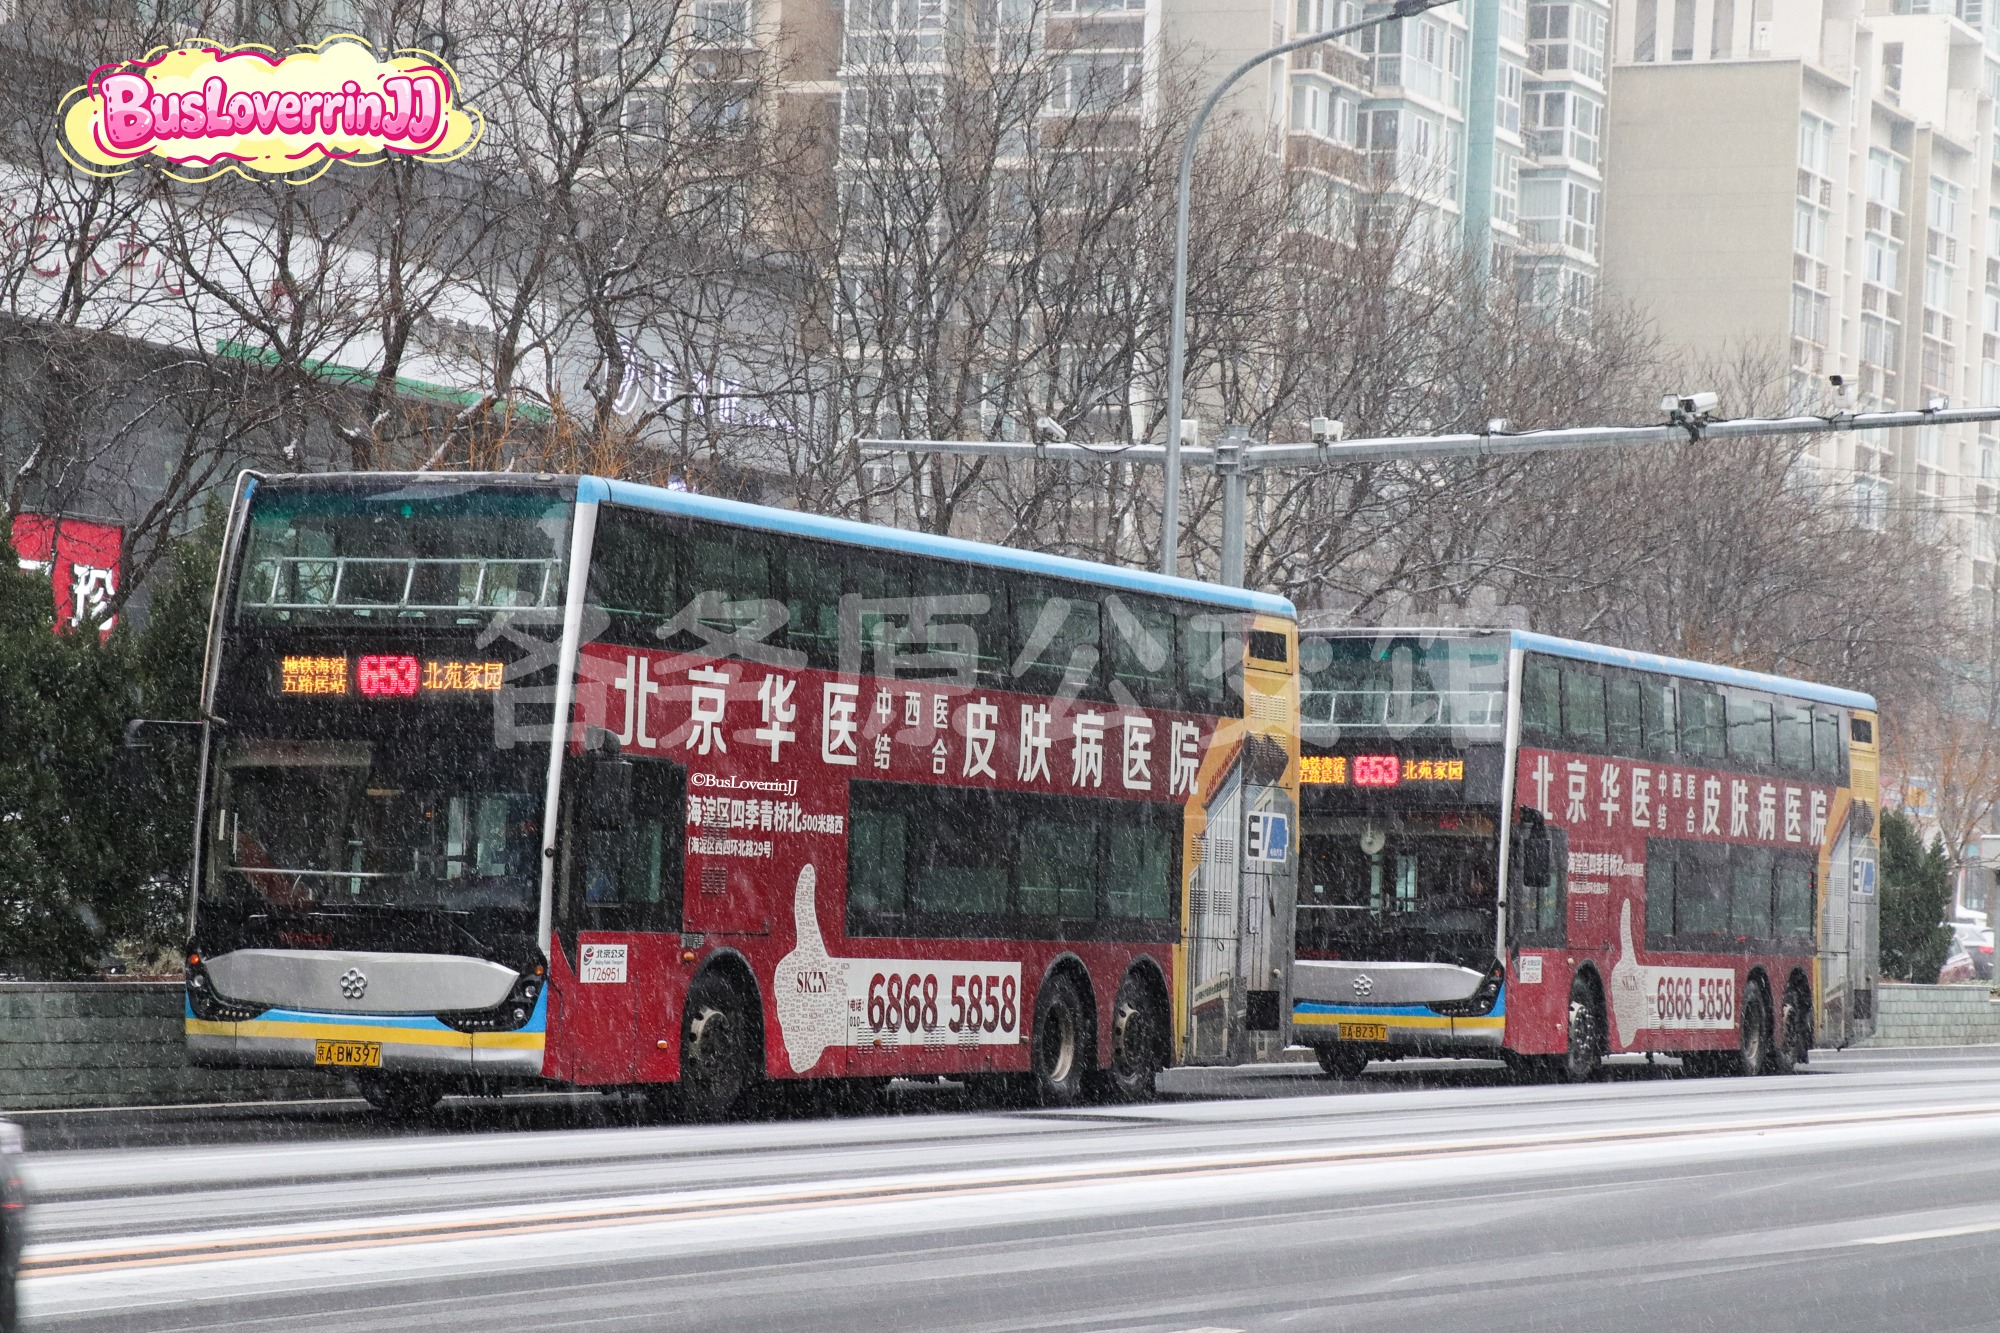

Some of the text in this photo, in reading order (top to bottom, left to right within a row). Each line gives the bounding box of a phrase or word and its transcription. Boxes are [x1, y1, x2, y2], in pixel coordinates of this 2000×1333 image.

[282, 656, 347, 674] 地铁海淀
[359, 656, 418, 695] 653
[282, 675, 347, 694] 五路居站
[423, 662, 504, 690] 北苑家园
[1354, 756, 1399, 785] 653
[1403, 760, 1464, 780] 北苑家园
[596, 949, 625, 959] 北京公交
[587, 967, 620, 981] 1726951
[796, 972, 828, 993] SKIN
[868, 973, 938, 1033] 6868
[948, 974, 1016, 1033] 5858
[1657, 976, 1732, 1020] 6868 5858
